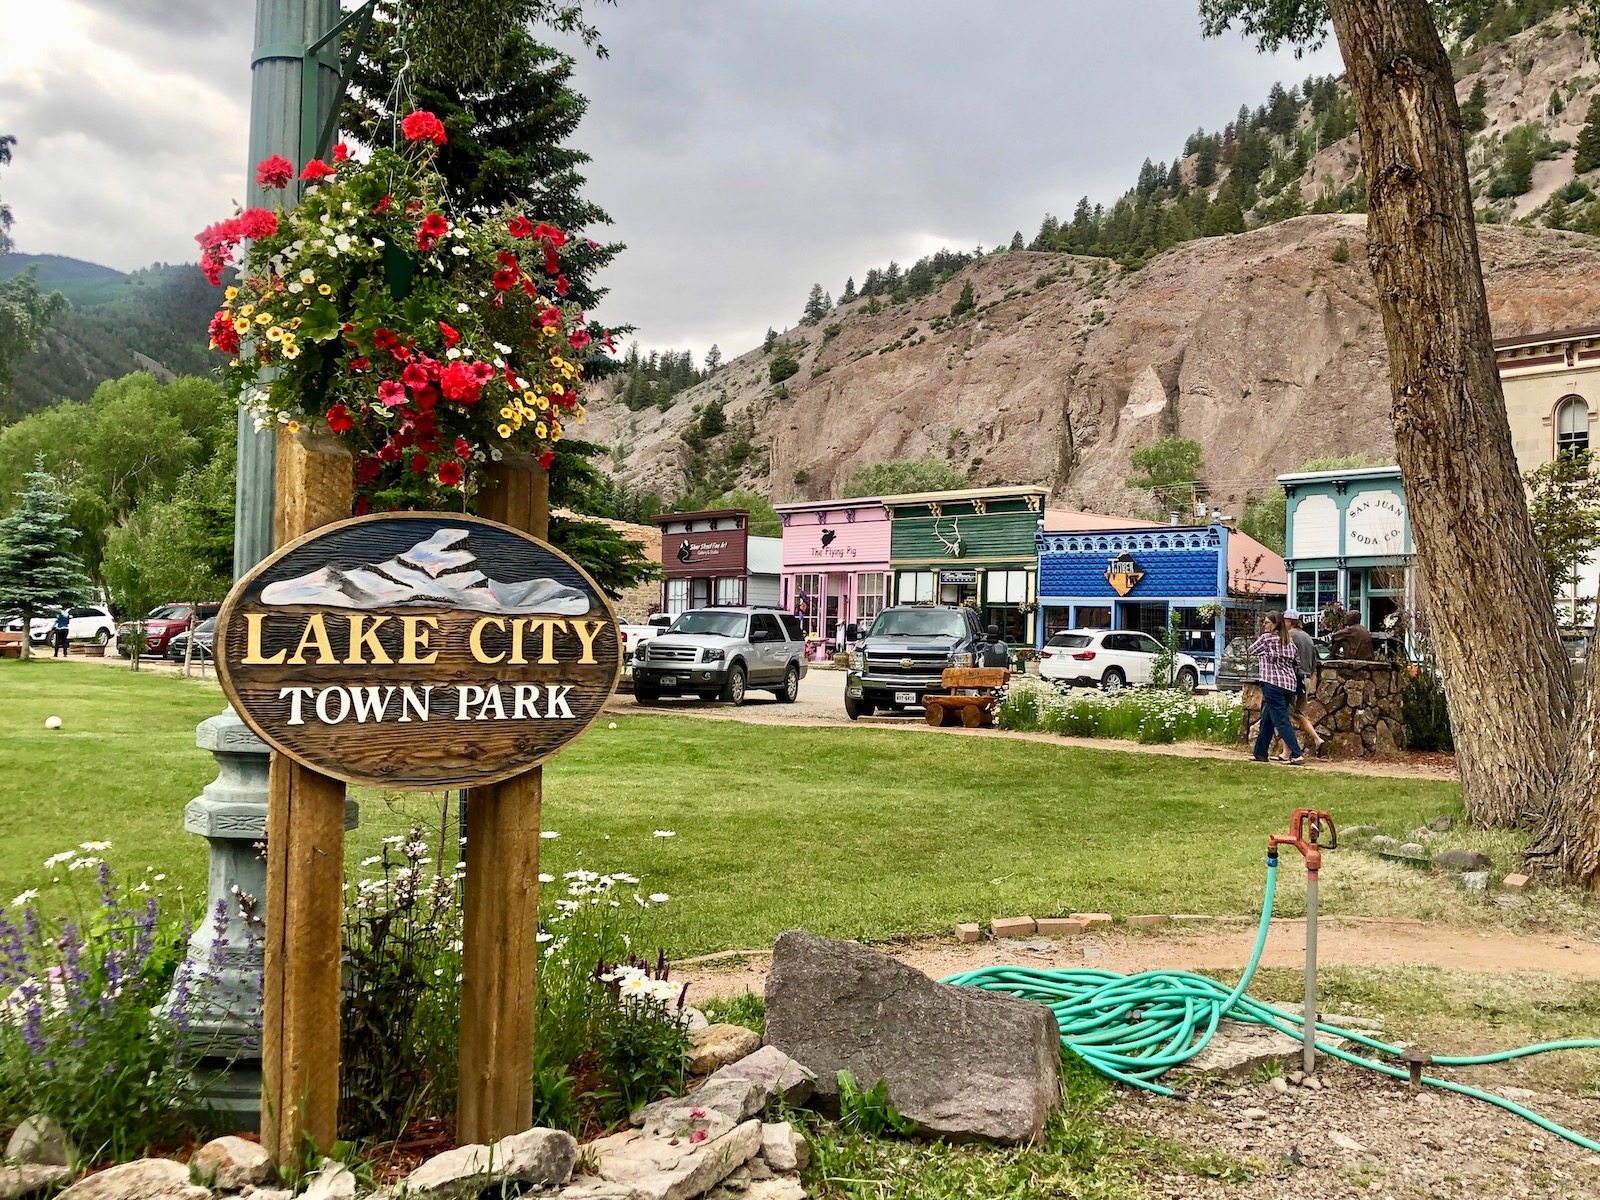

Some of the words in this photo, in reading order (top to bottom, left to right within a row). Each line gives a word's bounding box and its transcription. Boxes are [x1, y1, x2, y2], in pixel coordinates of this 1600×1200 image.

[1350, 502, 1369, 517] SAN
[1375, 500, 1402, 516] JUAN
[1351, 531, 1378, 544] SODA
[811, 548, 822, 556] The
[825, 547, 843, 558] Flying
[847, 546, 856, 557] Pig
[241, 614, 439, 664] LAKE
[469, 618, 608, 665] CITY
[278, 685, 434, 724] TOWN
[455, 685, 576, 719] PARK
